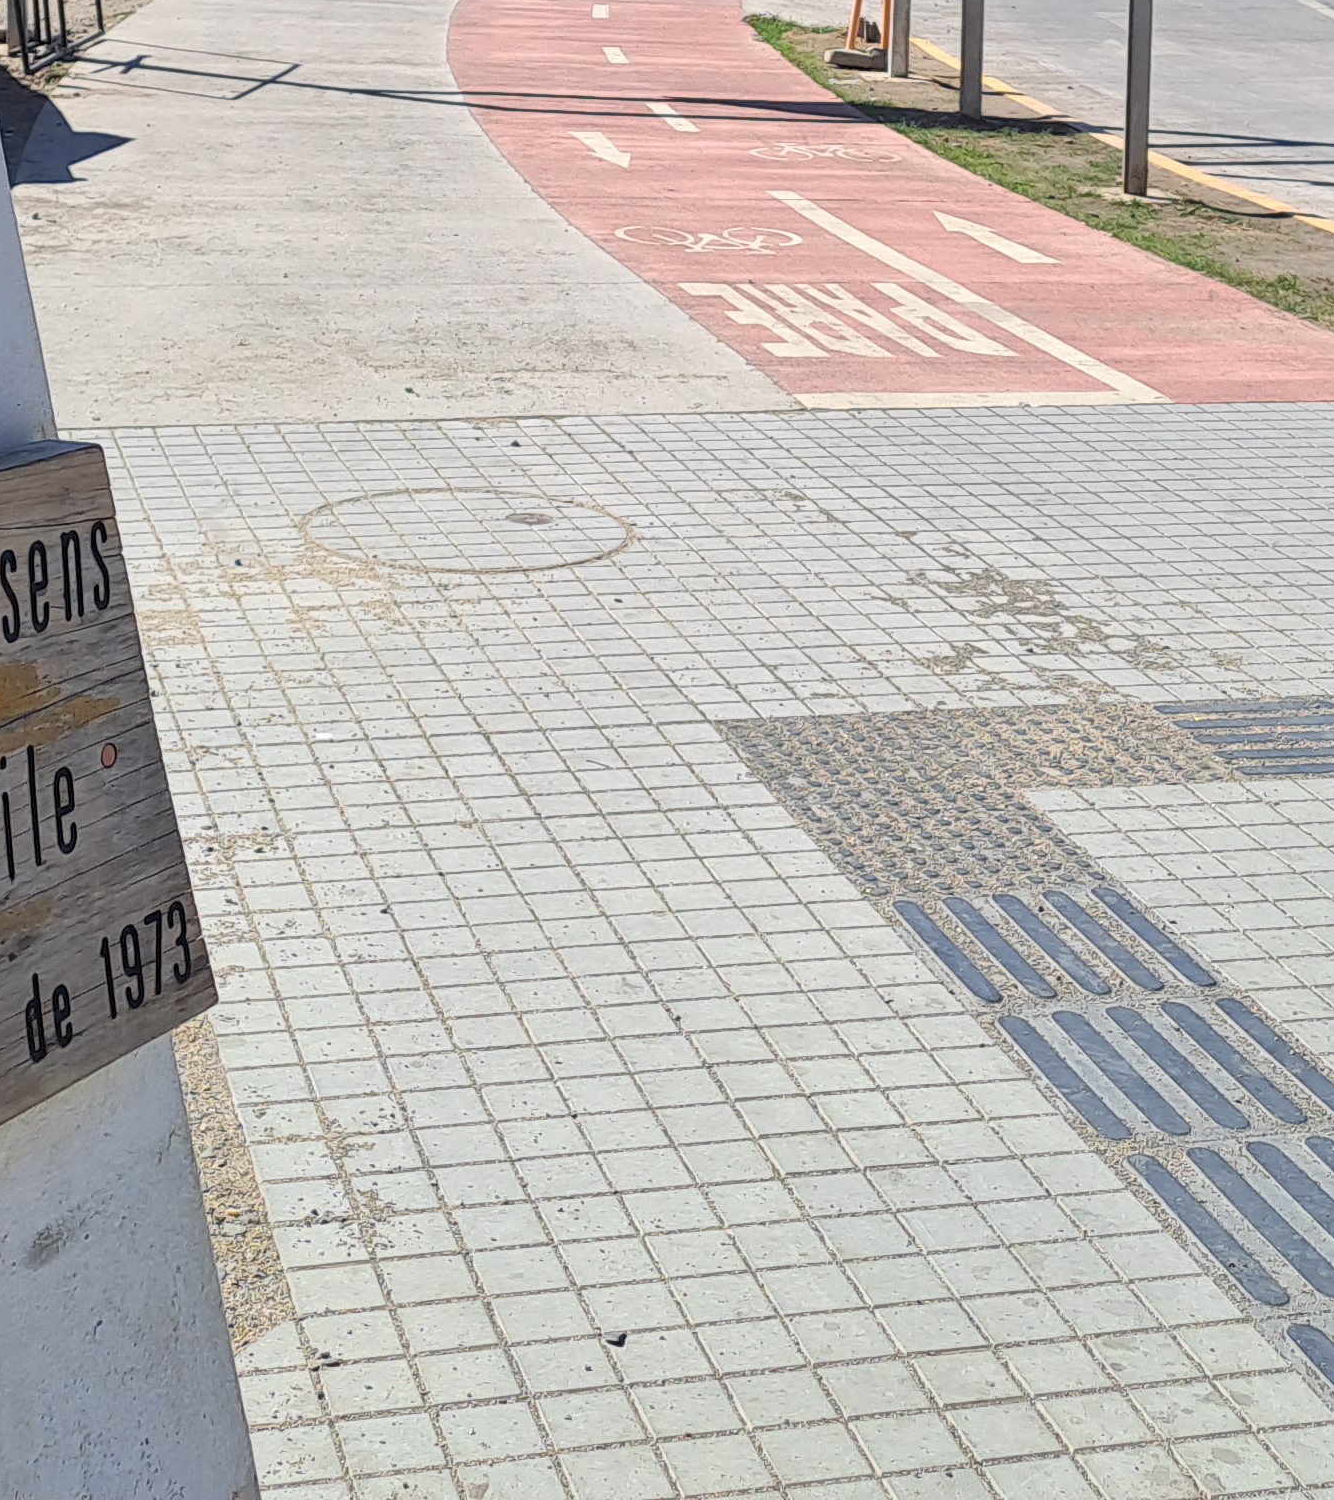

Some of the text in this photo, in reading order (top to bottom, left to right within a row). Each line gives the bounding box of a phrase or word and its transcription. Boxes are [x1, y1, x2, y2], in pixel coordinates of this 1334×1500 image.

[676, 282, 1020, 358] PARE
[25, 973, 74, 1065] de
[98, 900, 193, 1021] 1973
